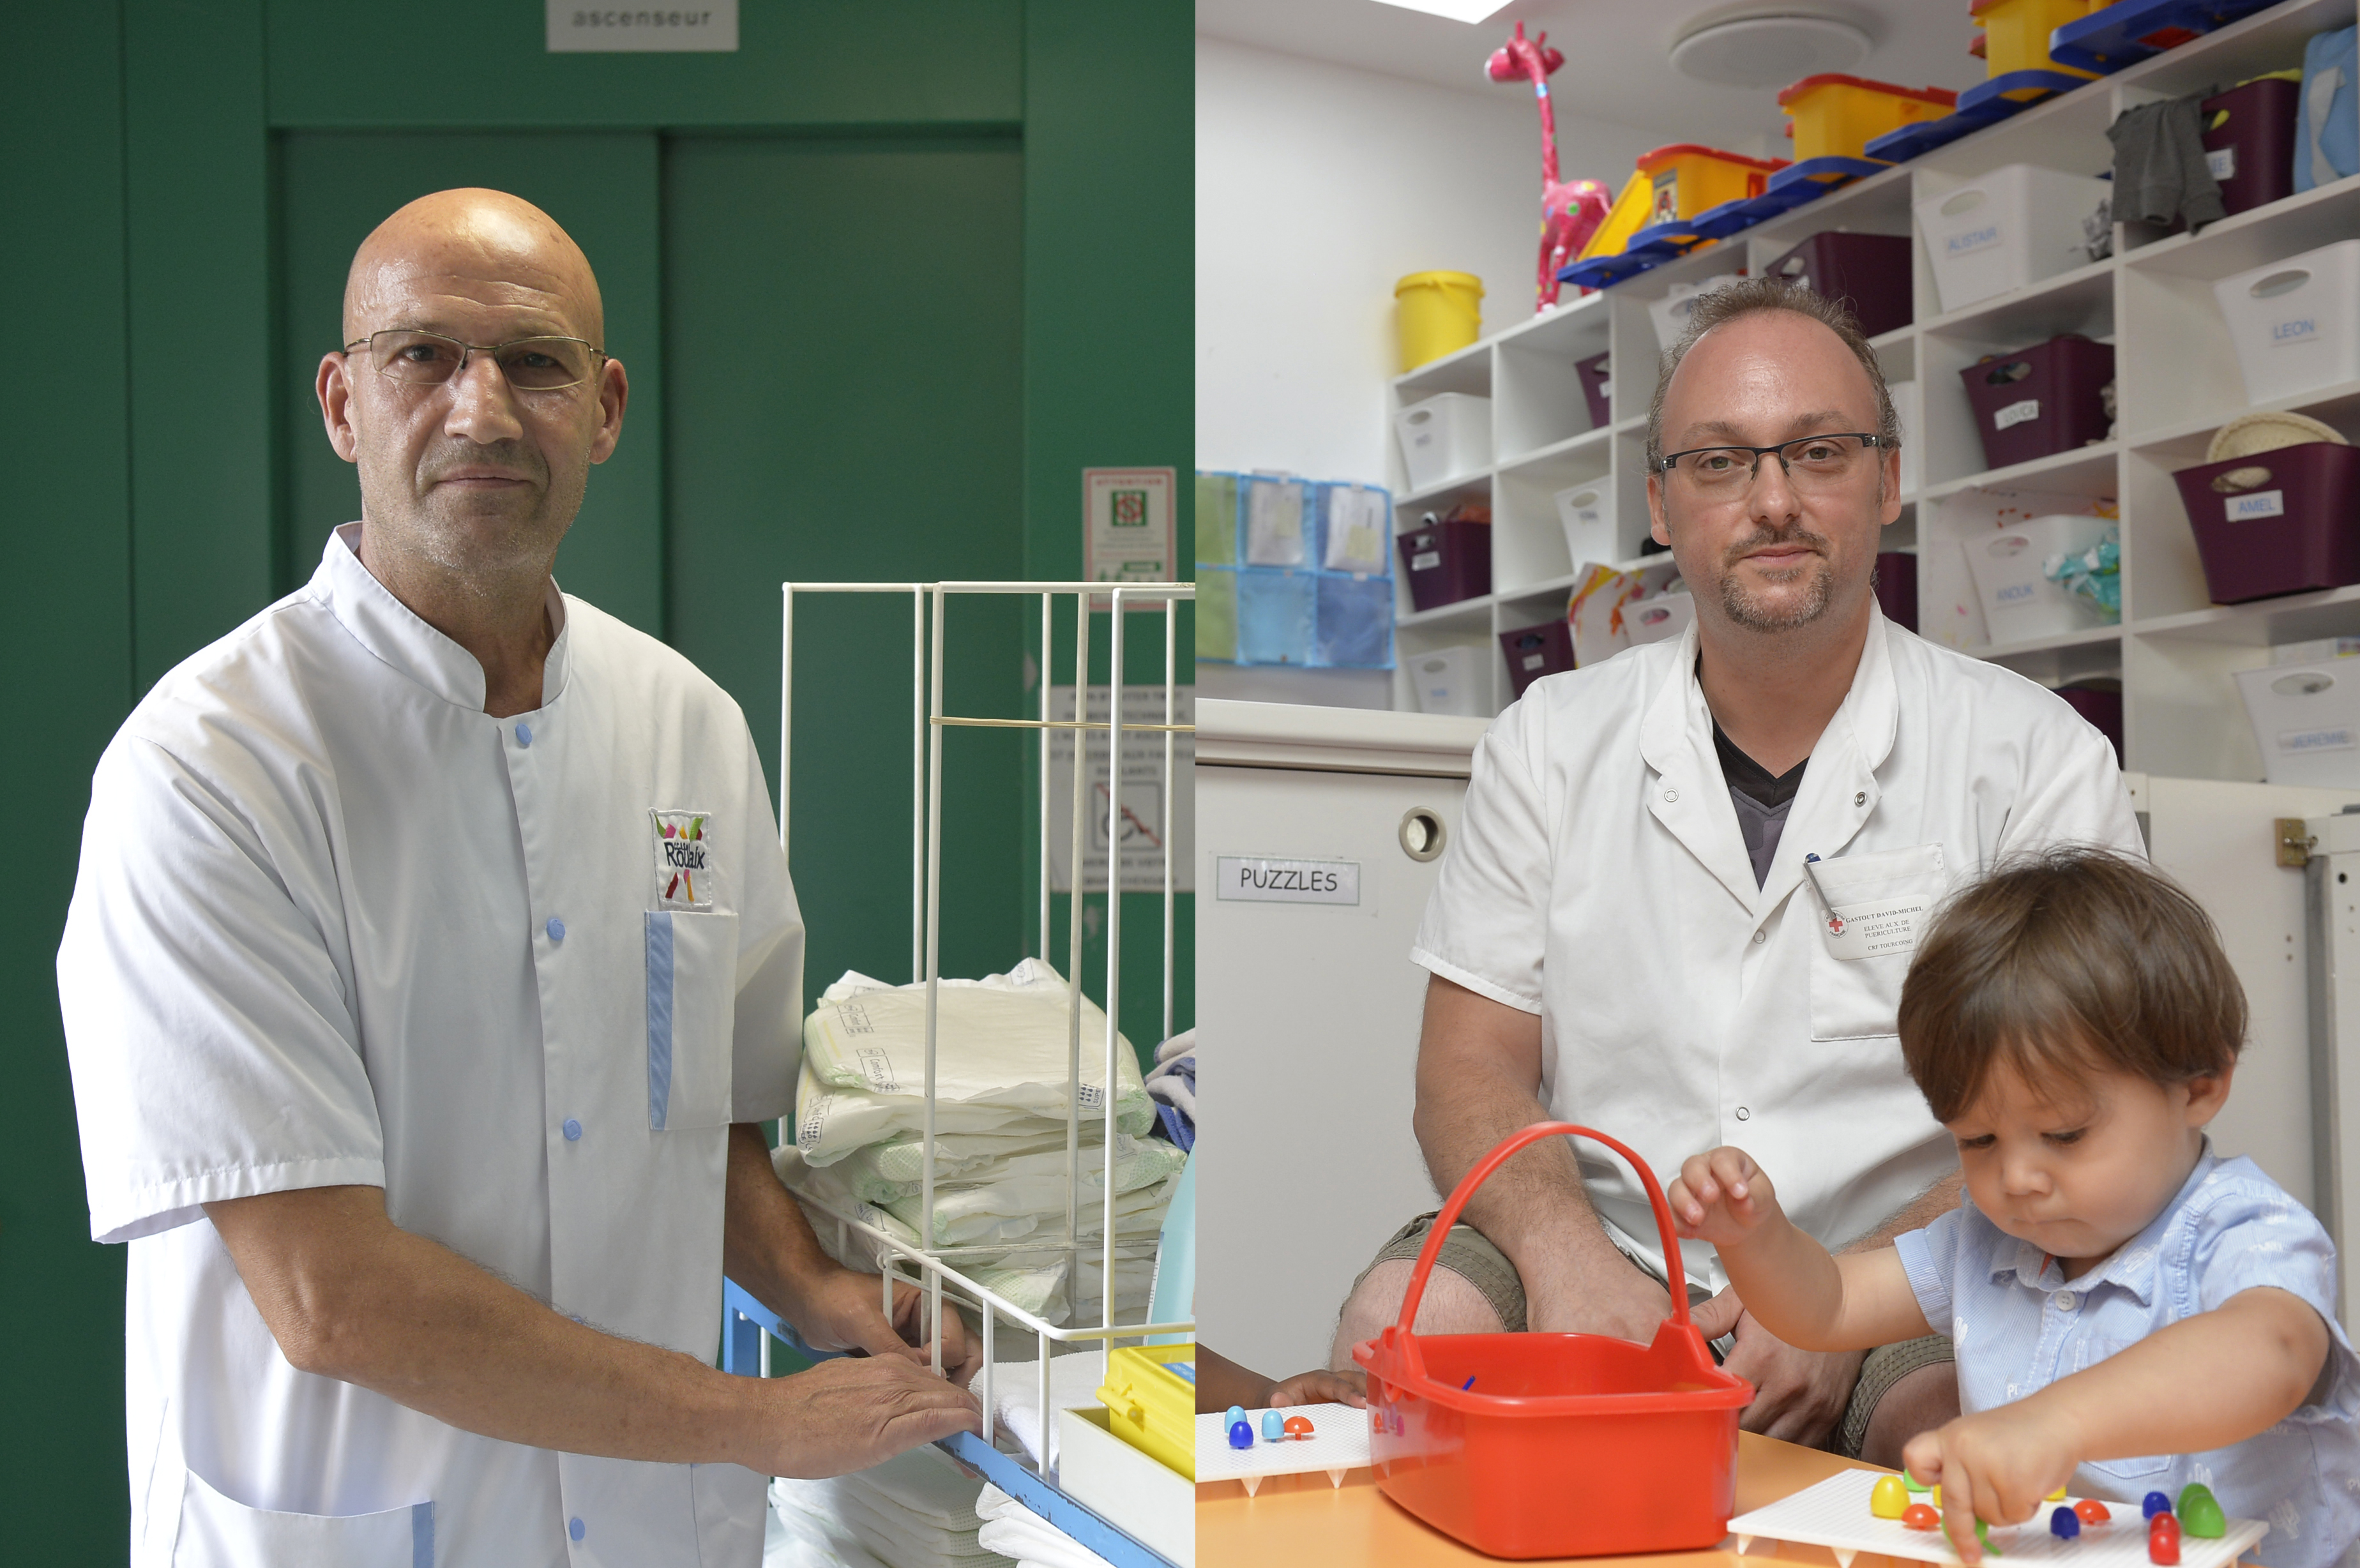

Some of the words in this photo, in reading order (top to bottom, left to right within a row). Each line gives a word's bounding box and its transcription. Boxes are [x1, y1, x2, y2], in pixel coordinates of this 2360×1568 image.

[572, 10, 711, 27] ascenseur
[2273, 319, 2315, 340] LEON
[2238, 498, 2276, 513] AMEL
[1997, 584, 2034, 601] ANOUK
[1241, 868, 1338, 891] PUZZLES
[1846, 914, 1875, 923] GASTOUT
[1877, 906, 1923, 917] DAVID-MICHEL
[1864, 924, 1884, 932] ELEVE
[1865, 926, 1911, 939] PUERICULTURE
[1880, 939, 1913, 949] TOURCOING
[870, 1059, 884, 1080] Comfort
